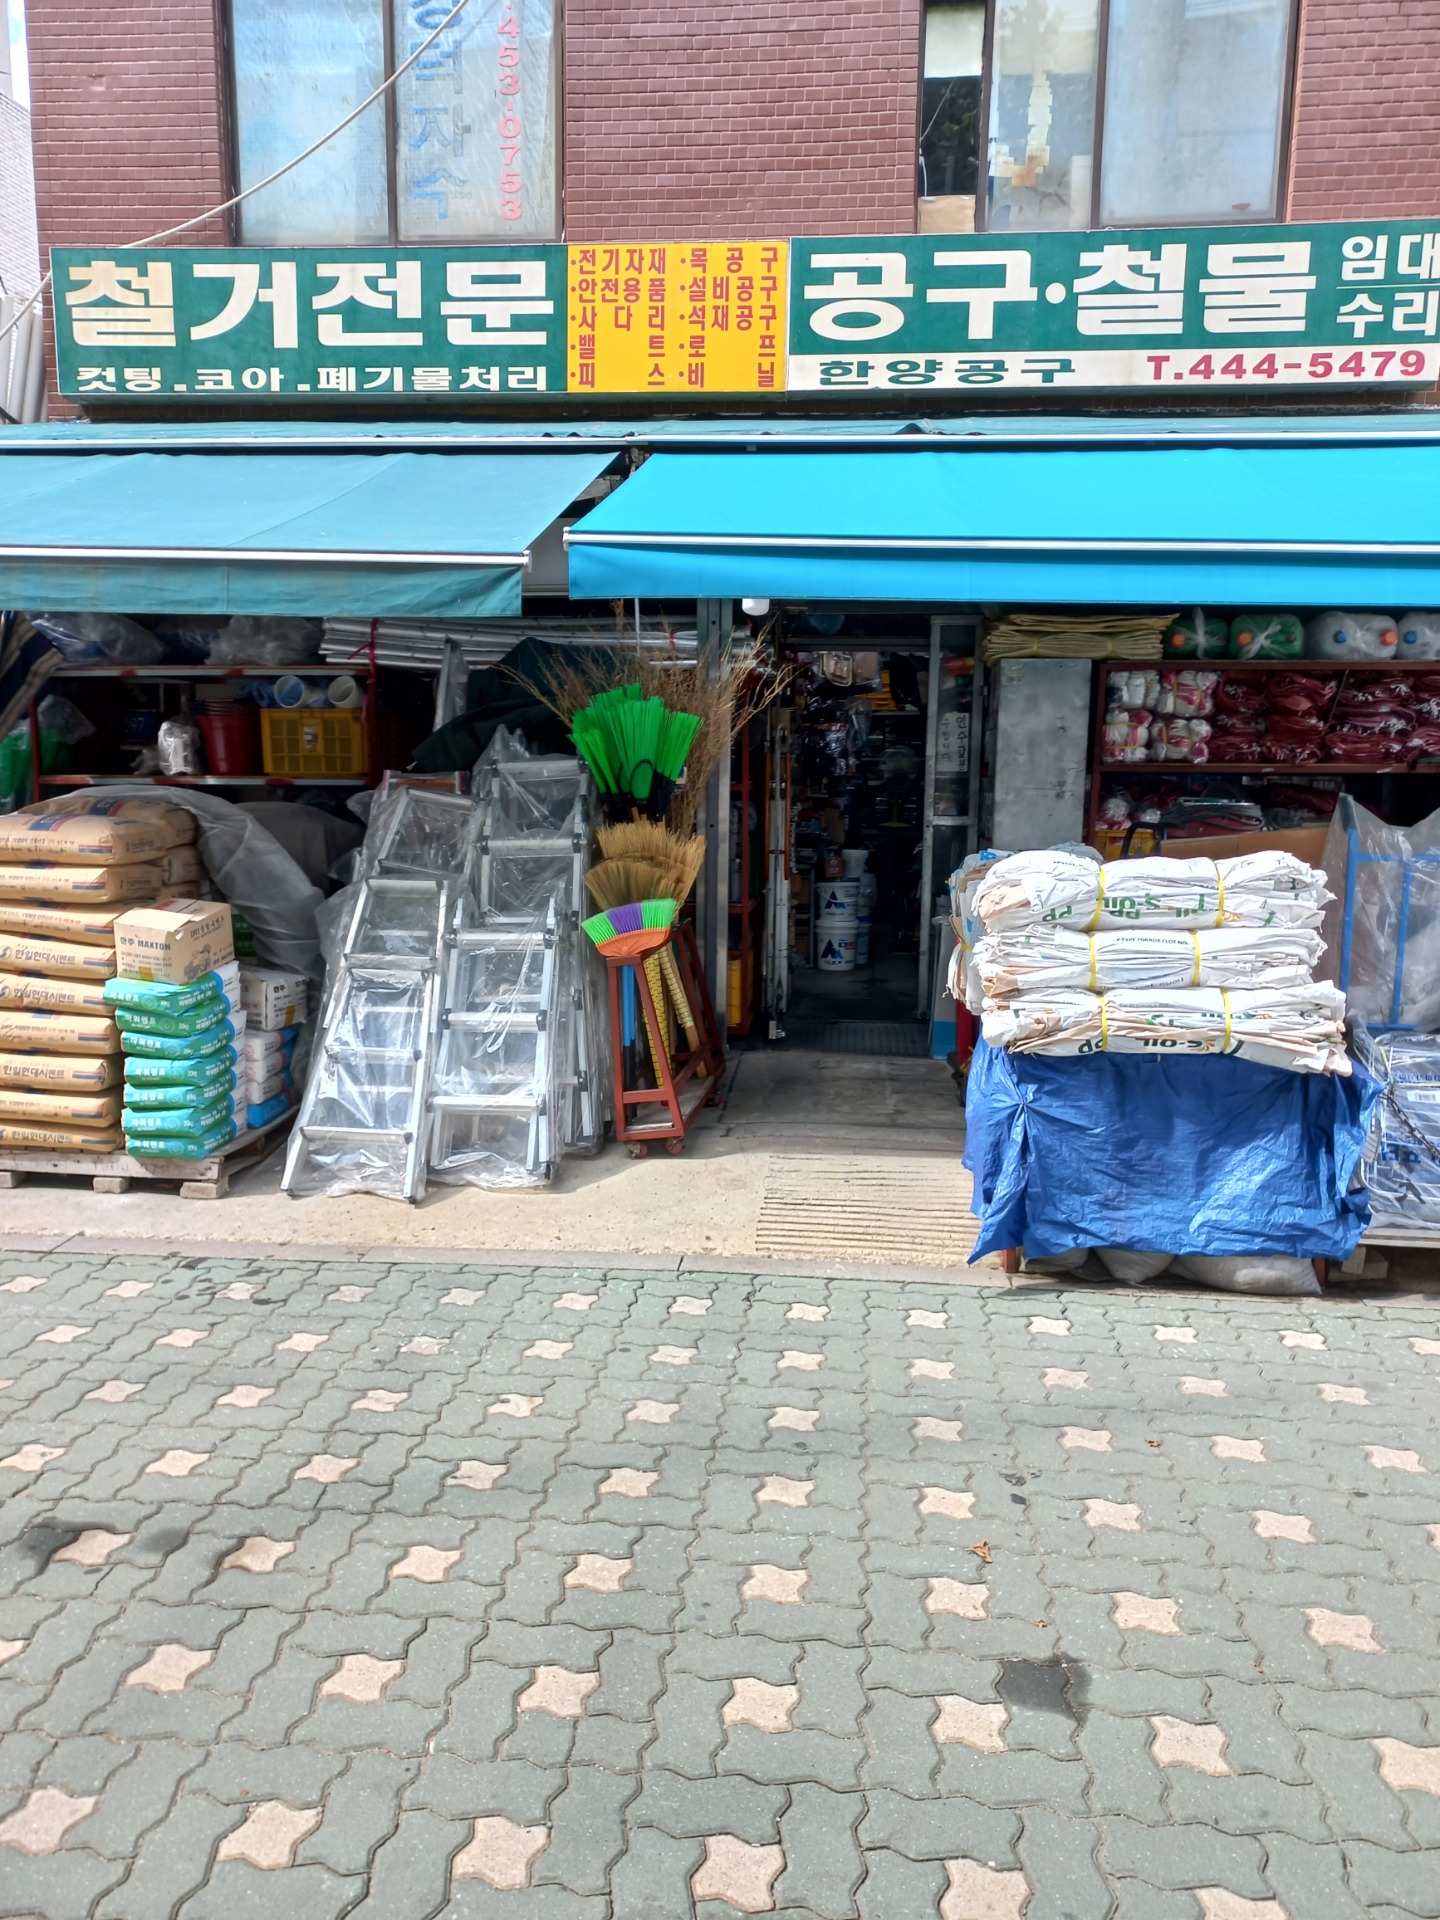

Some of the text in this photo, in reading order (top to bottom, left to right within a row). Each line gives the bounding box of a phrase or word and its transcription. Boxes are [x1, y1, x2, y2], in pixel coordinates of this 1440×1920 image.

[578, 248, 666, 275] 전기자재
[1341, 233, 1440, 282] 임대
[578, 277, 666, 304] 안전용품
[688, 275, 778, 303] 설비공구
[65, 260, 554, 349] 철거전문
[688, 304, 777, 332] 석재공구
[1336, 290, 1440, 340] 수리
[818, 357, 1076, 386] 한양공구
[1146, 349, 1426, 381] T.444-5479
[138, 939, 171, 951] MAXTON
